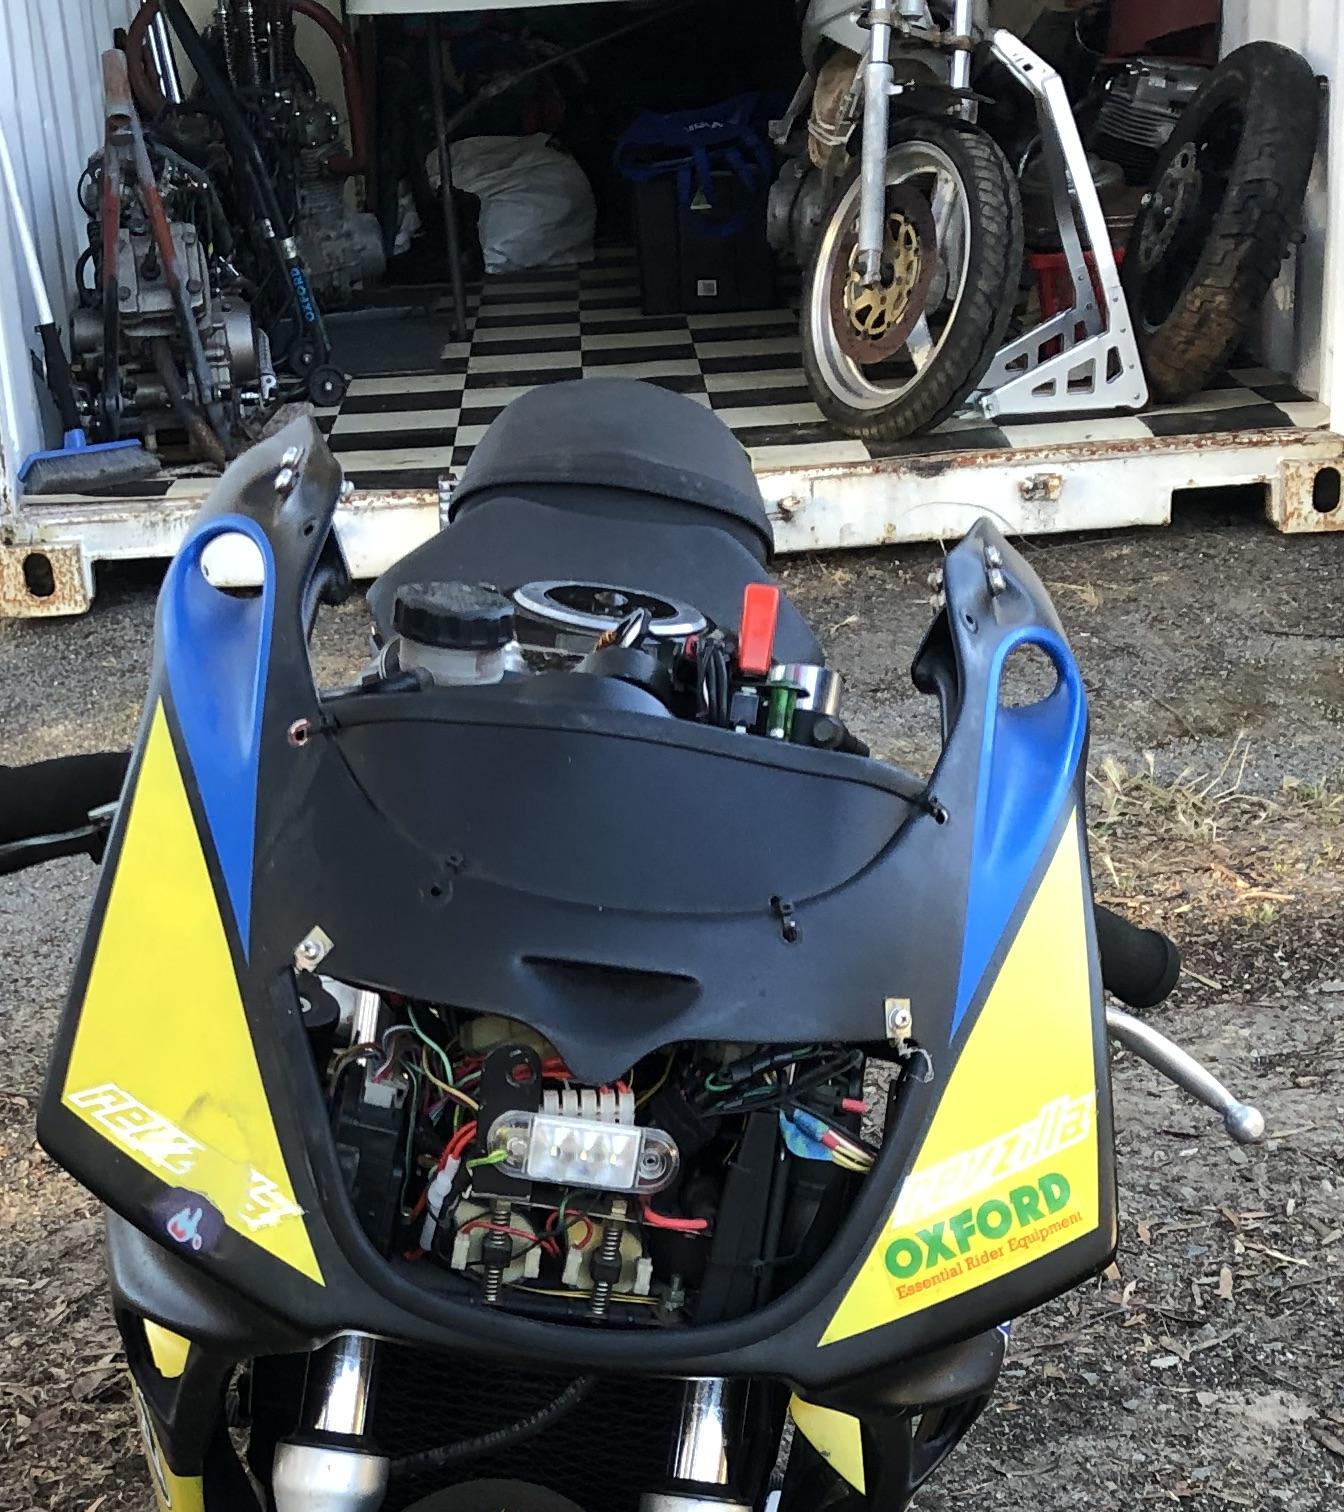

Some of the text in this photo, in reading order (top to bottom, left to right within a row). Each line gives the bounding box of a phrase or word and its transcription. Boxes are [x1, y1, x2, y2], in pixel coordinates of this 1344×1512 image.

[885, 1173, 1071, 1279] OXFORD
[896, 1211, 1083, 1299] Essential Rider Equipment
